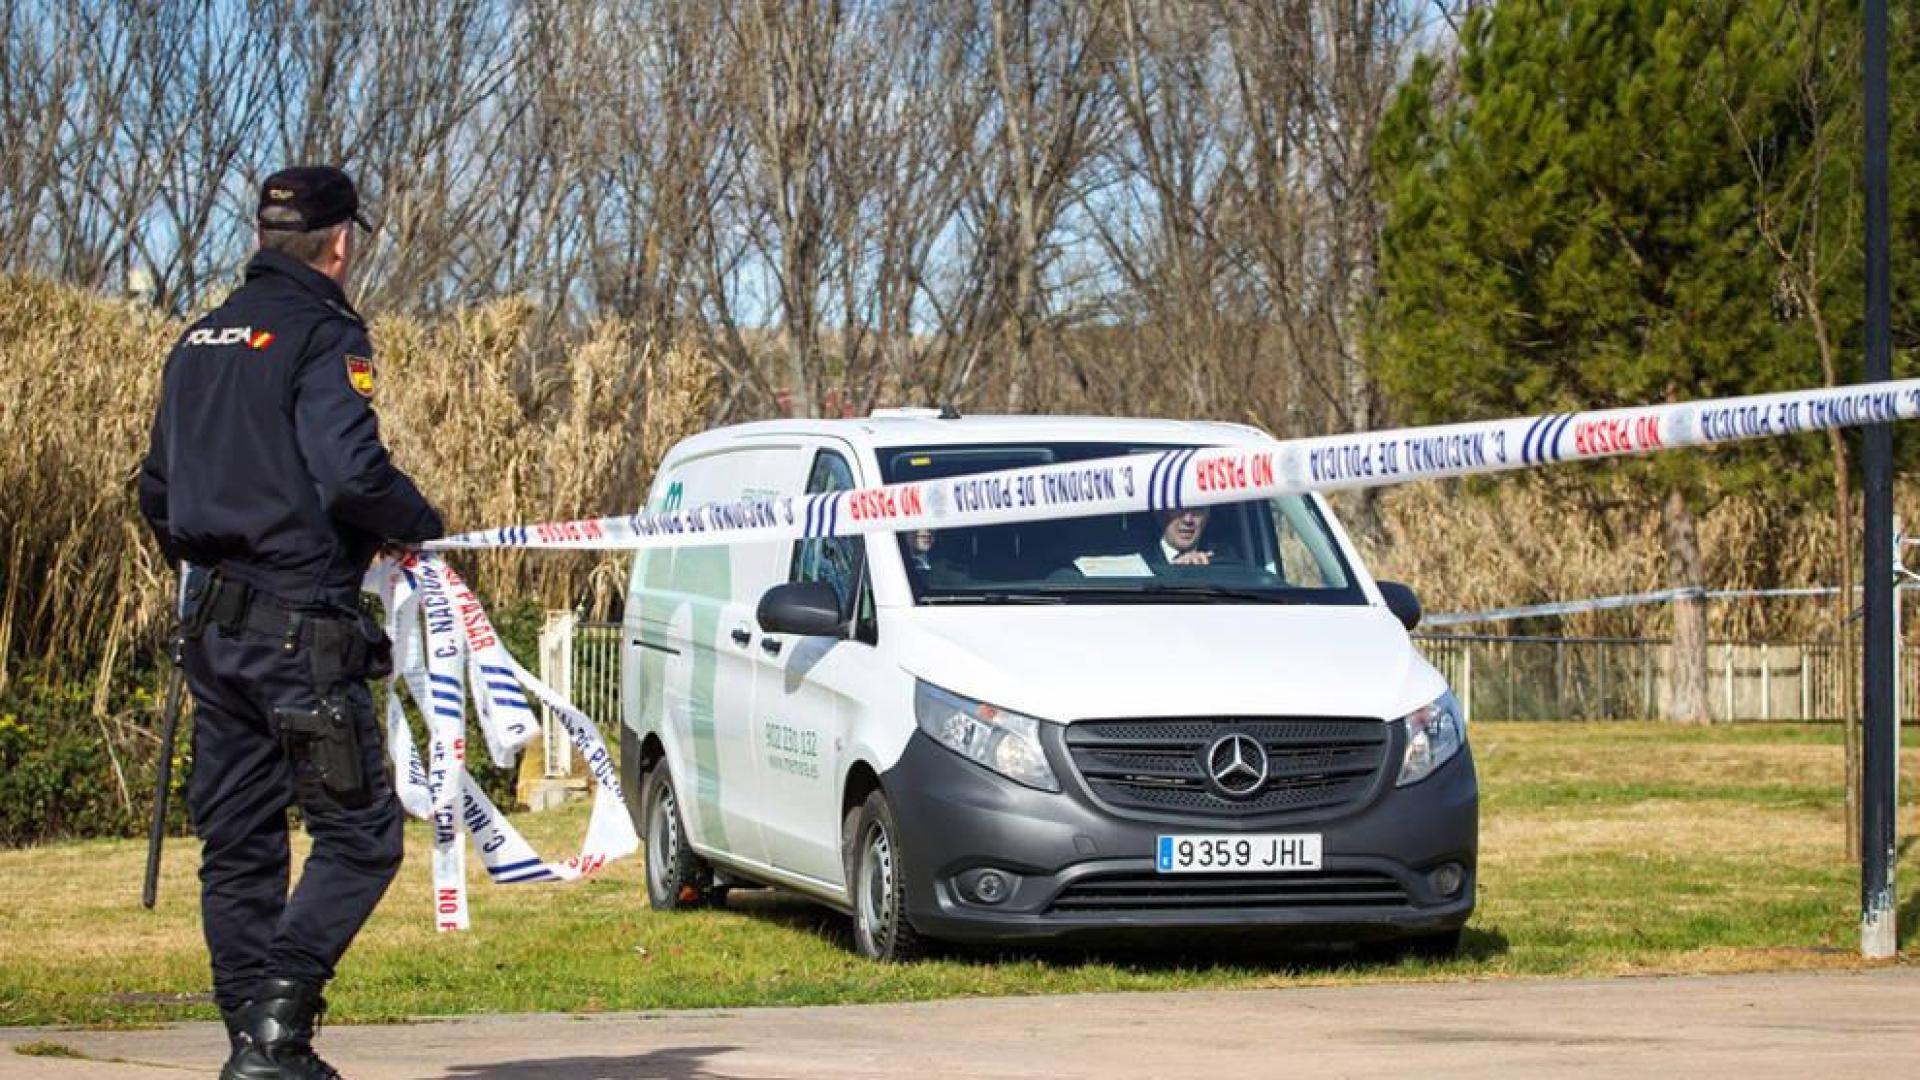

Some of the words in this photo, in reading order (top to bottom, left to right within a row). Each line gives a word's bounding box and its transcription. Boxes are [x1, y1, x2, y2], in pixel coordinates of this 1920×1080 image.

[1700, 403, 1771, 441] POLICIA
[1778, 402, 1800, 433] DE
[1808, 391, 1901, 428] NACIONAL
[1491, 430, 1506, 464] C.
[1575, 419, 1632, 455] PASAR
[1636, 416, 1662, 450] NO
[1310, 444, 1373, 481] POLICIA
[1379, 441, 1398, 474] DE
[1404, 431, 1486, 472] NACIONAL
[1041, 468, 1115, 504] NACIONAL
[1120, 465, 1135, 498] C.
[1196, 455, 1247, 492] PASAR
[1250, 453, 1274, 488] NO
[849, 490, 896, 520] PASAR
[900, 488, 922, 515] NO
[953, 478, 1012, 512] POLICIA
[1017, 476, 1036, 509] DE
[709, 499, 777, 531] NACIONAL
[456, 591, 495, 652] PASAR
[1178, 839, 1251, 867] 9359
[1262, 839, 1314, 866] JHL
[439, 889, 458, 914] NO
